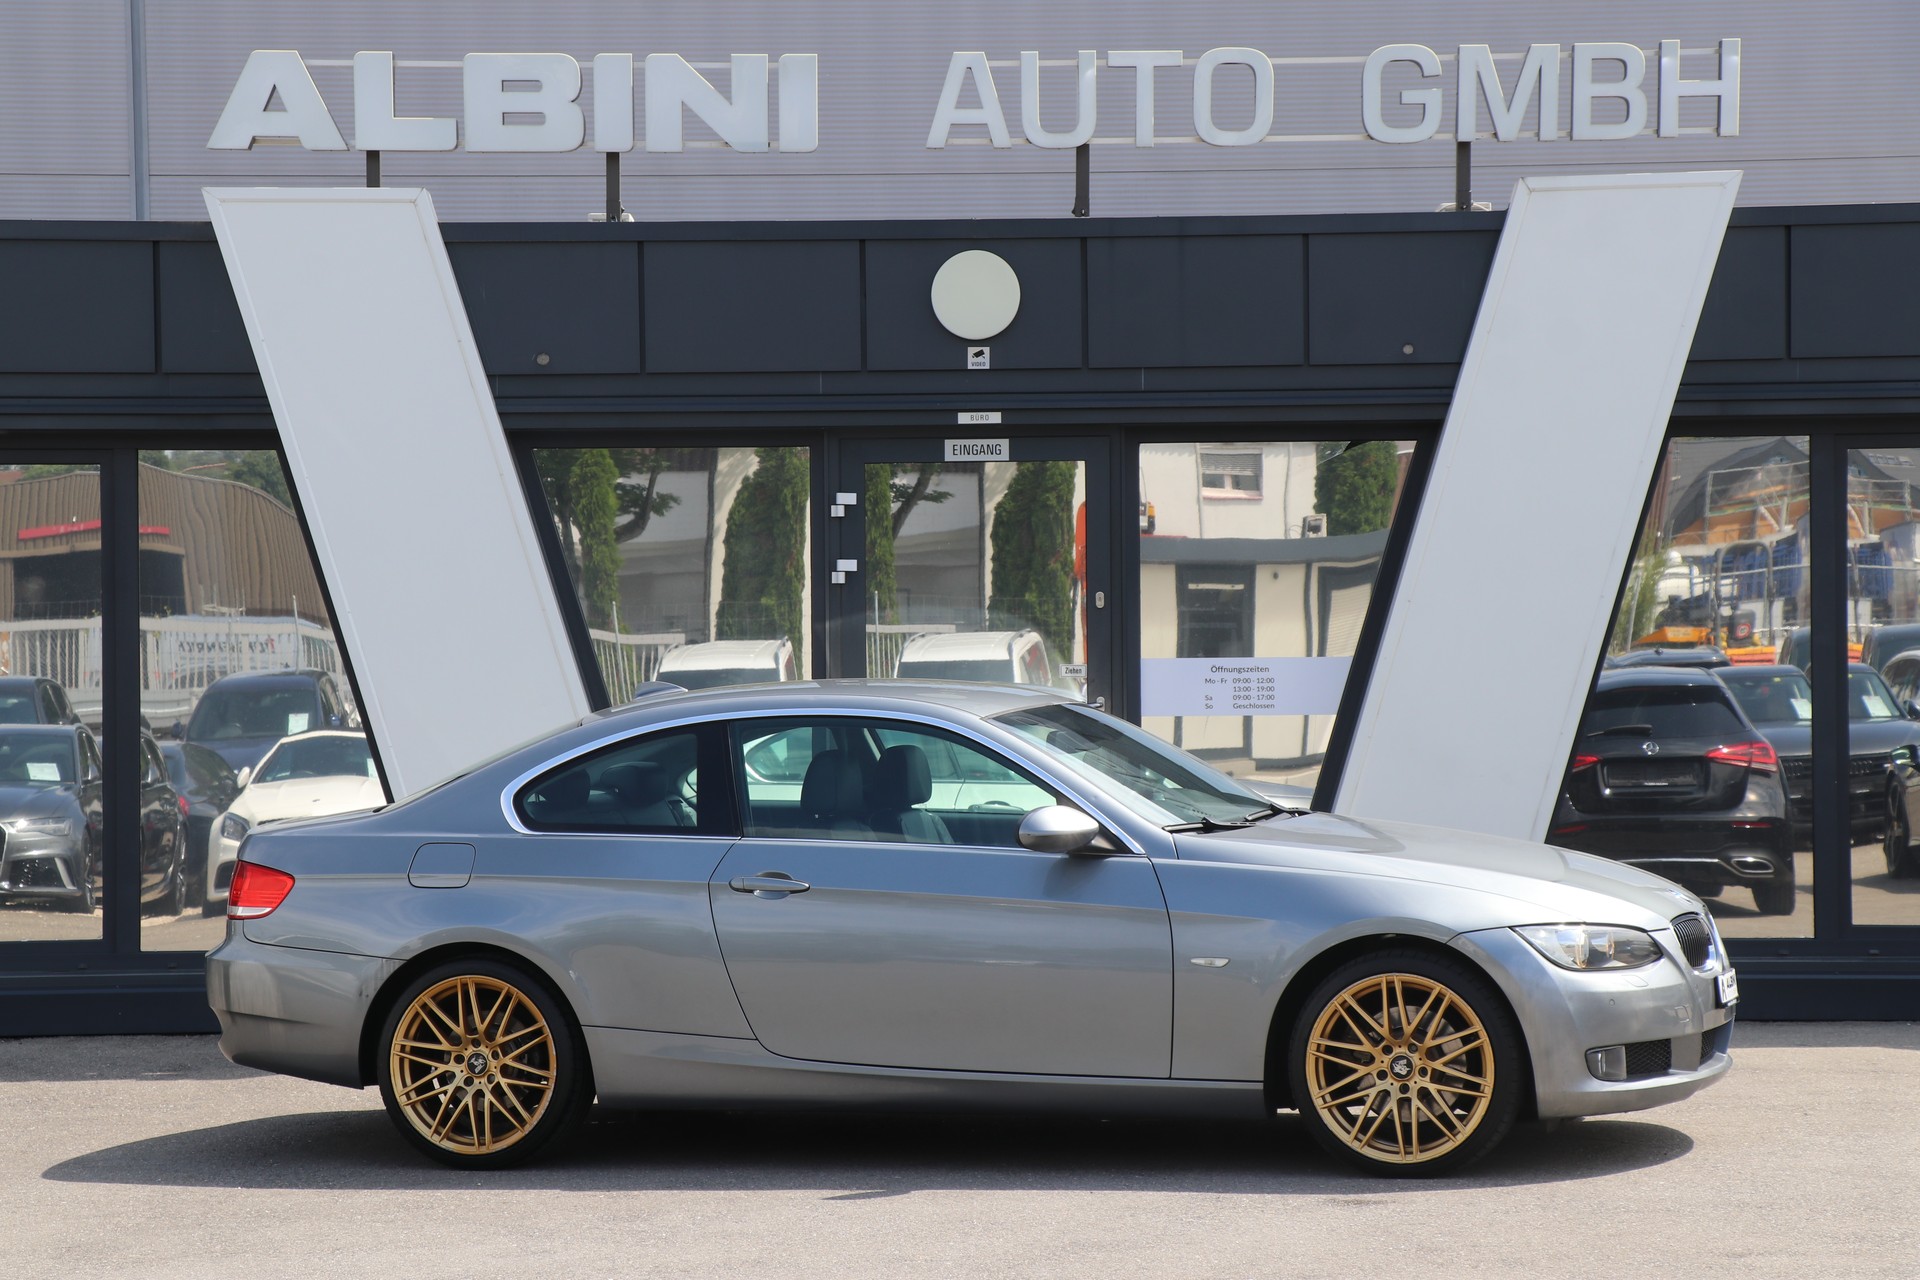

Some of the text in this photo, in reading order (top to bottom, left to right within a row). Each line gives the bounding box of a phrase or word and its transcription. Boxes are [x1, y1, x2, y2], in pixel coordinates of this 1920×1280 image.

[206, 38, 1741, 153] ALBINI AUTO GMBH
[952, 443, 1002, 456] EINGANG
[1210, 665, 1270, 674] Öffnungszeiten
[1232, 702, 1275, 710] Geschlossen
